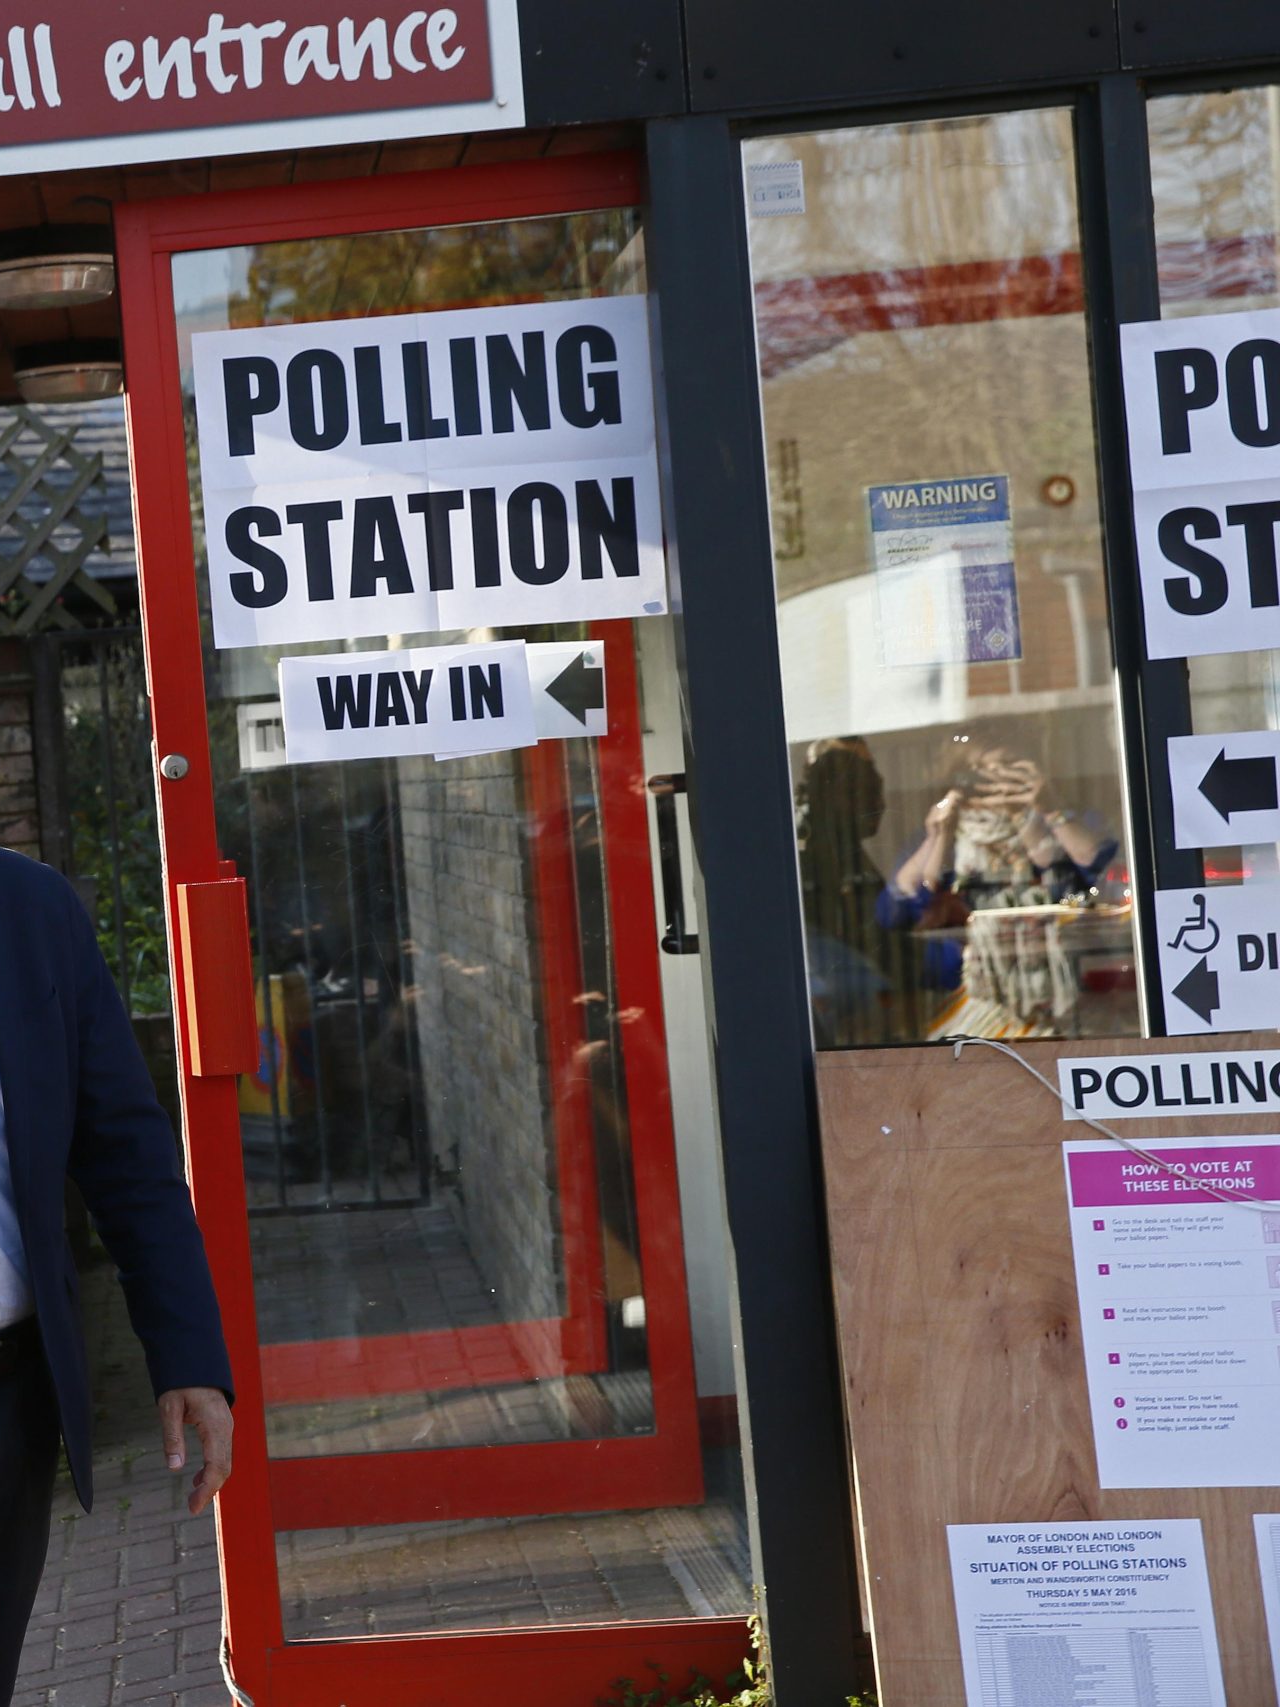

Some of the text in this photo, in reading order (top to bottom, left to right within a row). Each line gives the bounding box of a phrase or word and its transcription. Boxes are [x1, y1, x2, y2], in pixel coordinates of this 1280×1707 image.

[103, 8, 467, 103] entrance
[223, 324, 622, 457] POLLING
[881, 482, 996, 509] WARNING
[225, 476, 640, 608] STATION
[316, 663, 505, 731] WAY IN
[1122, 1161, 1252, 1176] HOW TO VOTE AT
[1123, 1177, 1255, 1192] THESE ELECTIONS
[987, 1531, 1162, 1544] MAYOR OF LONDON AND LONDON
[1017, 1543, 1135, 1555] ASSEMBLY ELECTIONS
[970, 1557, 1188, 1573] SITUATION OF POLLING STATIONS
[990, 1574, 1169, 1585] MERTON AND WANDSWORTH CONSTITUENCY
[1027, 1587, 1137, 1599] THURSDAY 5 MAY 2016
